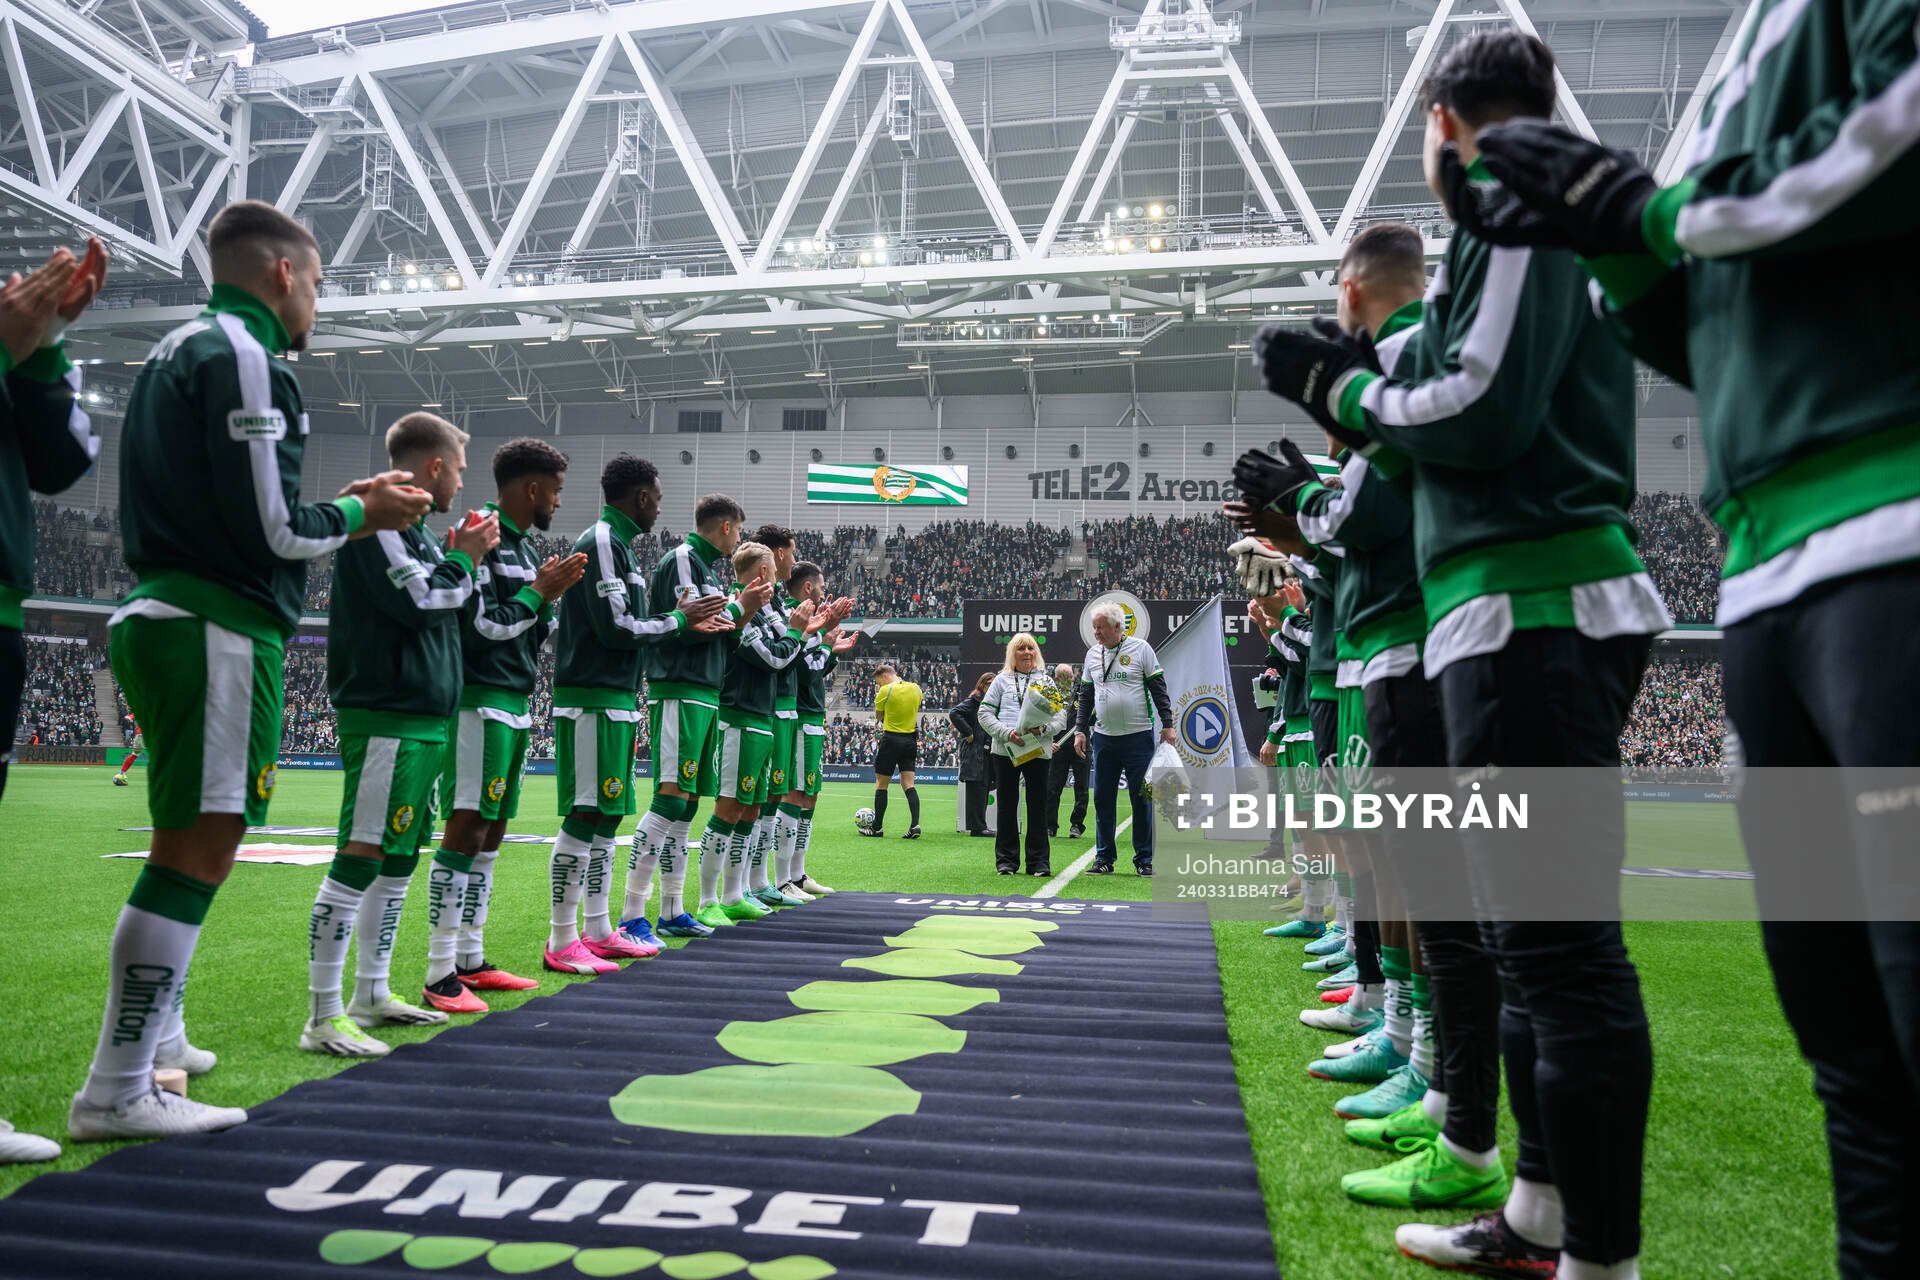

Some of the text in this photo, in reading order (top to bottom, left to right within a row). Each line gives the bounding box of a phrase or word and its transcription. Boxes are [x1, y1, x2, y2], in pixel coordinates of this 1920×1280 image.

[1027, 461, 1242, 502] TELE2 Arena
[979, 613, 1063, 633] UNIBET
[1167, 614, 1251, 634] UET
[729, 833, 747, 867] linton.
[893, 897, 1130, 913] UNIBET
[265, 1159, 1020, 1248] UNIBET
